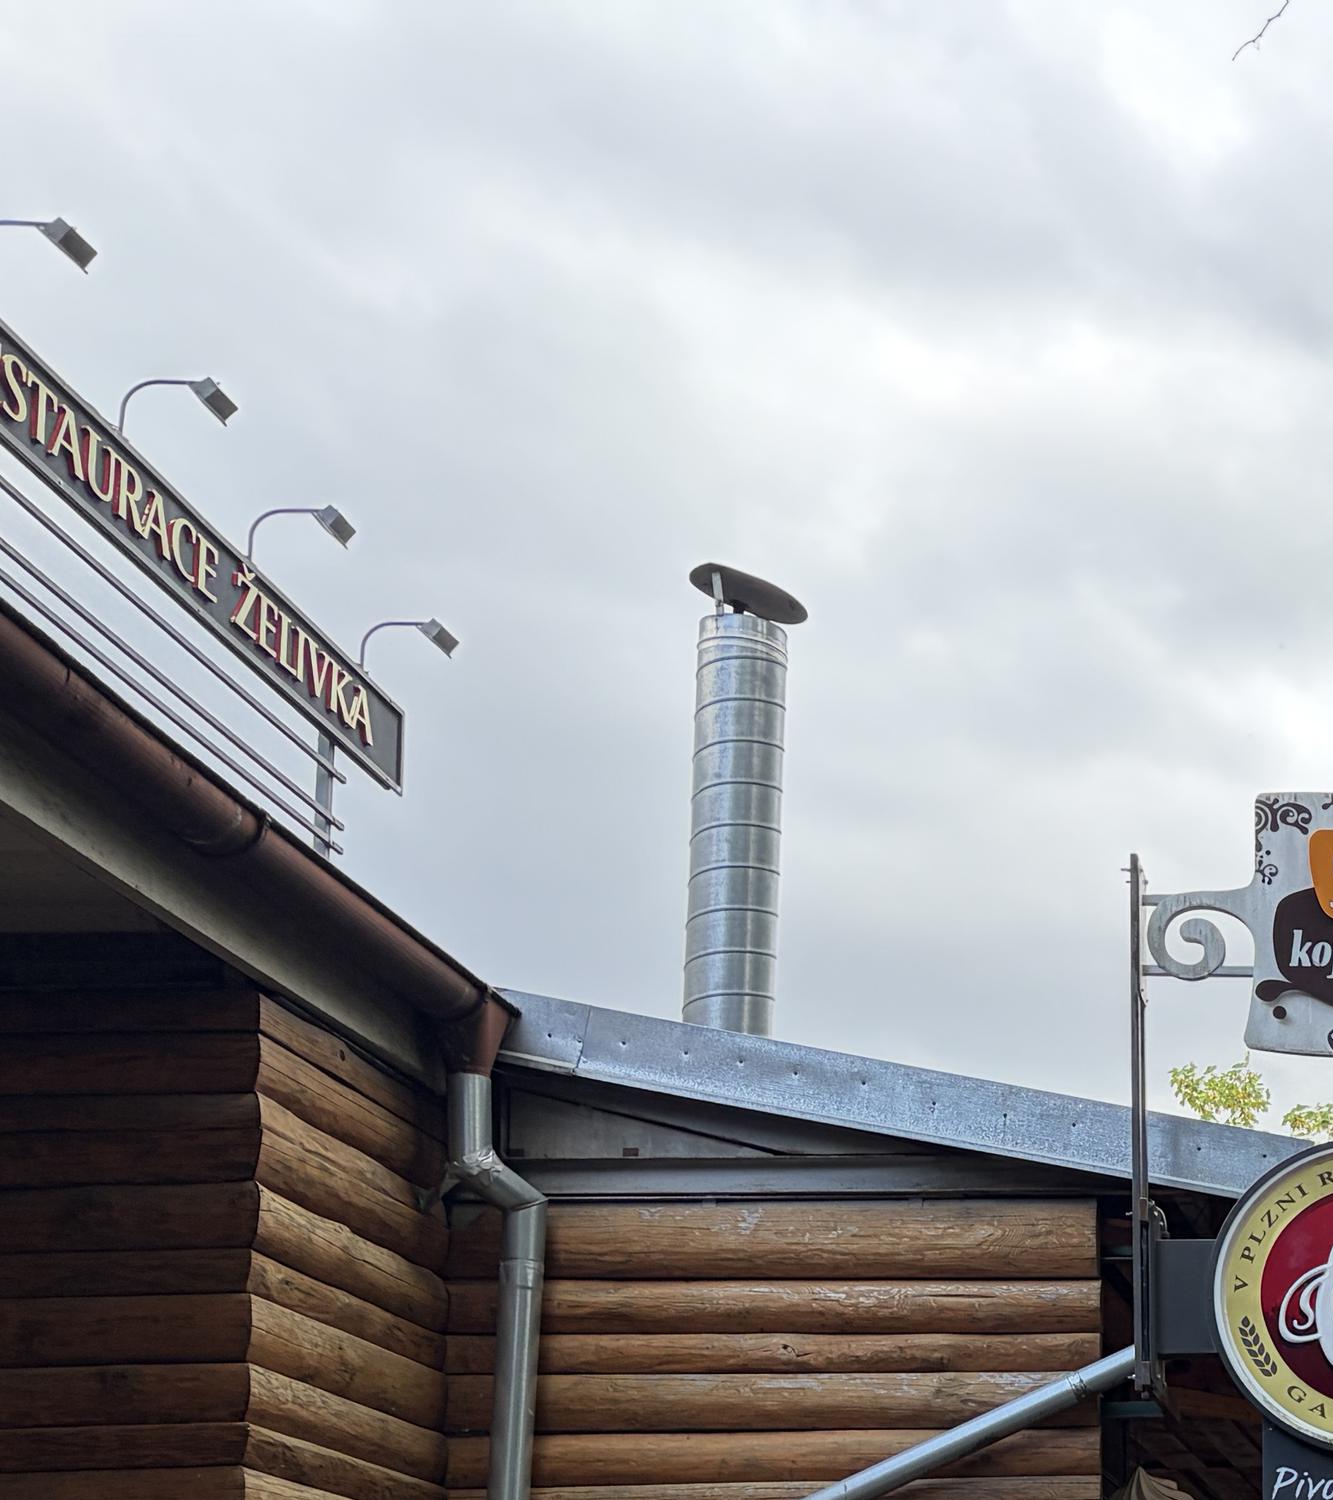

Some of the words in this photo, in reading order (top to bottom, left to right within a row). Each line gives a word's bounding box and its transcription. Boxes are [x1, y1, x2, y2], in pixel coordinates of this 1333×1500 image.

[0, 347, 218, 604] STAURACE
[230, 563, 374, 747] ŽELIVKA
[1240, 1183, 1309, 1264] PLZNI
[1233, 1275, 1249, 1293] V
